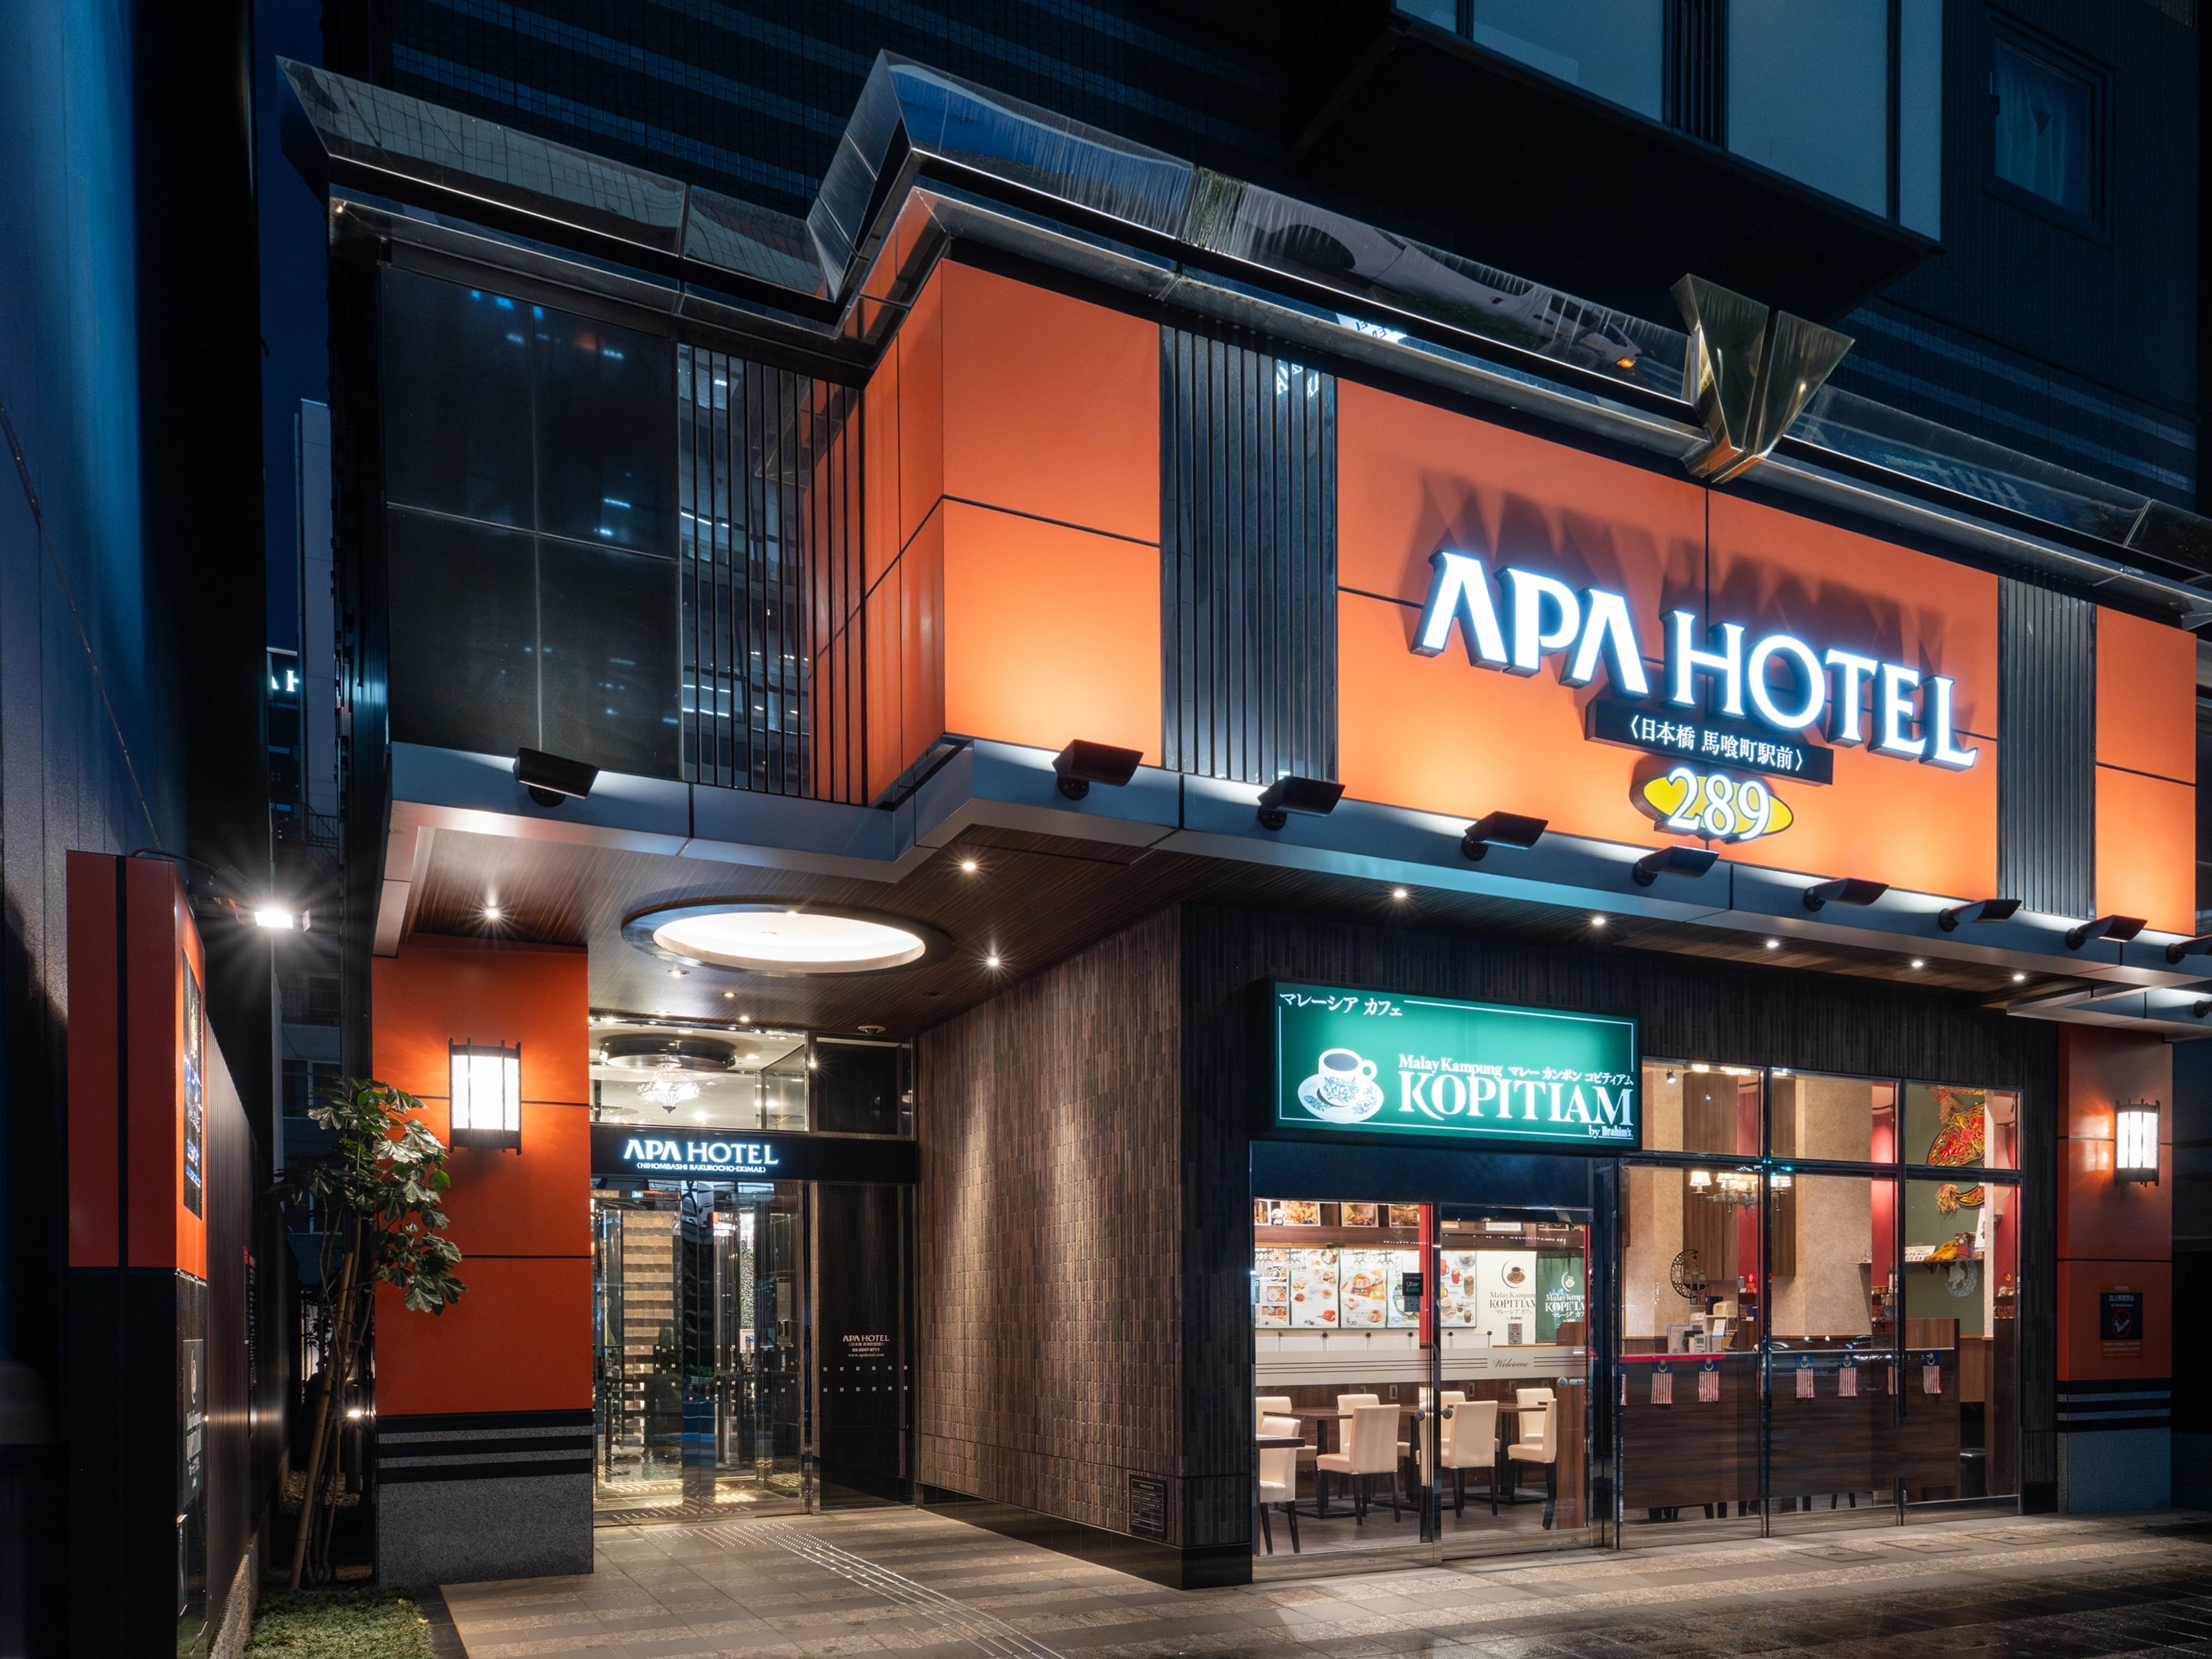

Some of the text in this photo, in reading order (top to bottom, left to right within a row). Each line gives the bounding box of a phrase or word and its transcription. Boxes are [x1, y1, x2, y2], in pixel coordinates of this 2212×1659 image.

[1415, 549, 1979, 770] APA HOTEL
[1667, 767, 1771, 840] 289
[1279, 992, 1403, 1017] マレーシア カフェ
[1398, 1054, 1504, 1080] Malay Kampung
[1508, 1067, 1540, 1077] マレー
[1398, 1070, 1634, 1126] KOPITIAM
[1588, 1125, 1600, 1138] by
[623, 1139, 779, 1165] APA HOTEL
[1492, 1358, 1530, 1367] Welcome
